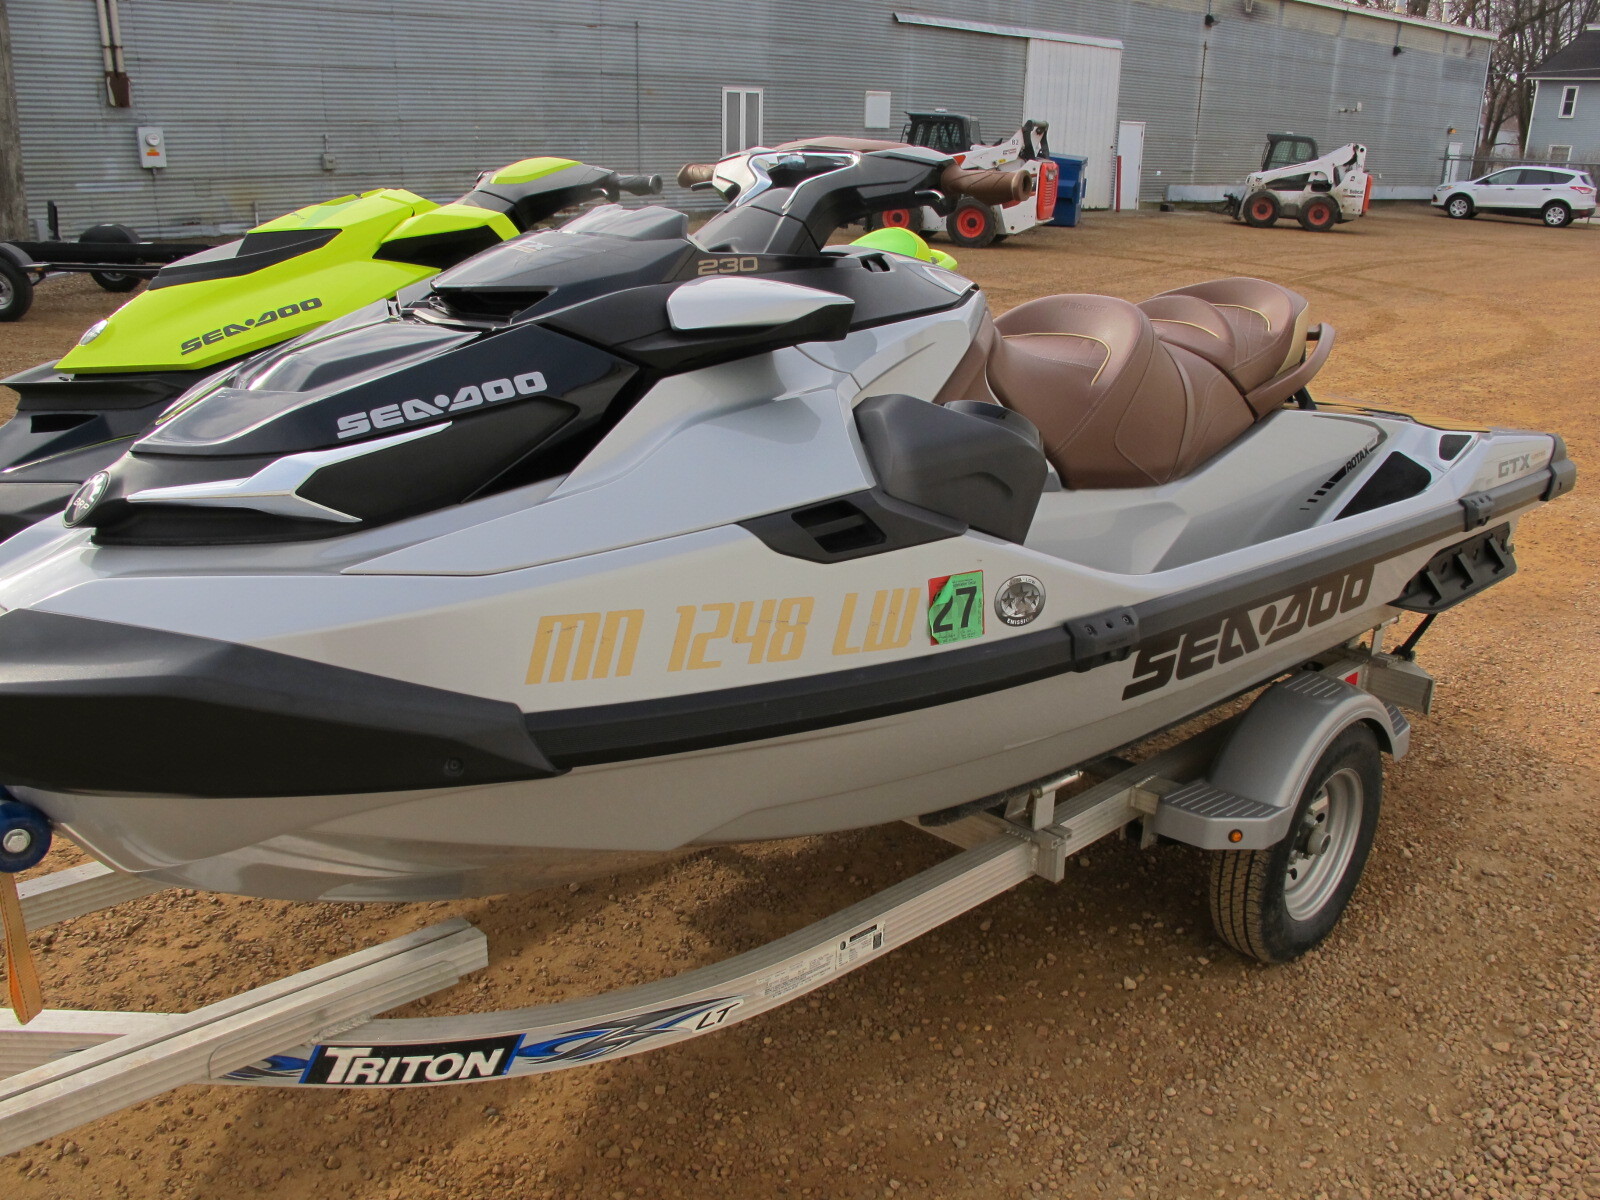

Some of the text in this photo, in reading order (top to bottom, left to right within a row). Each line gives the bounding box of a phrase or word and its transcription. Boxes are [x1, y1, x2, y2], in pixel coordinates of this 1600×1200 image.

[697, 256, 758, 276] 230
[1346, 445, 1370, 473] ROTAX
[1497, 453, 1530, 479] GTX
[73, 497, 90, 510] BRP
[932, 585, 978, 634] 27
[524, 609, 645, 685] MN
[666, 596, 815, 672] 1248
[832, 587, 921, 656] LW
[695, 1002, 740, 1031] LT
[324, 1047, 505, 1084] TRITON
